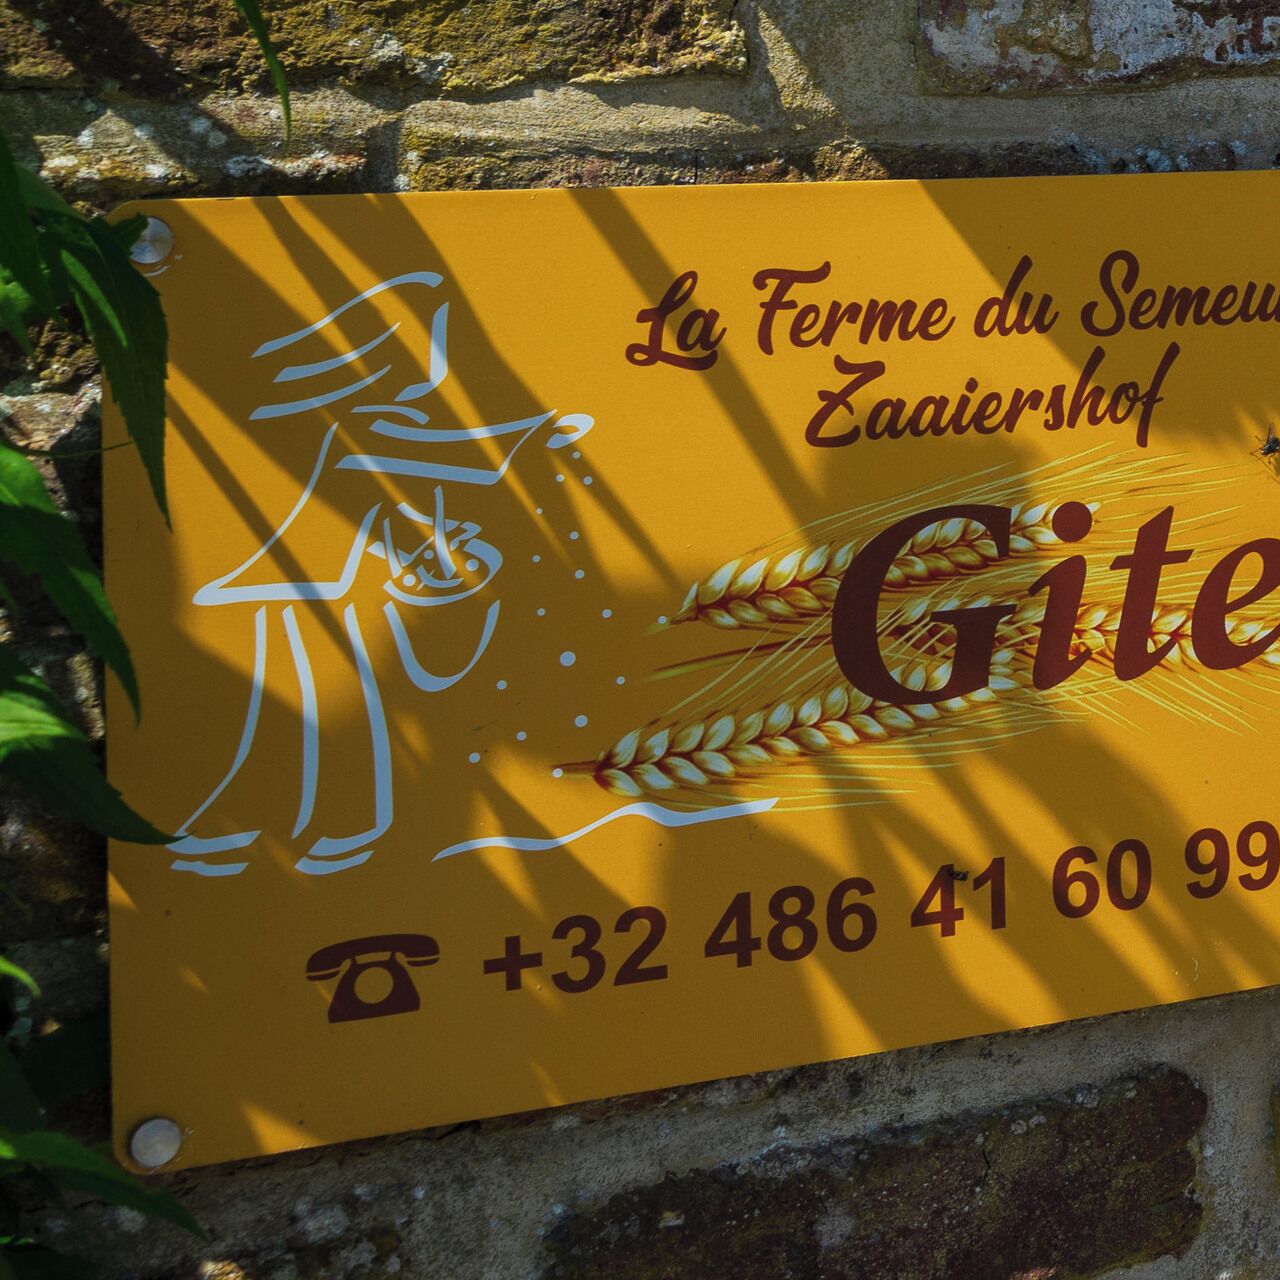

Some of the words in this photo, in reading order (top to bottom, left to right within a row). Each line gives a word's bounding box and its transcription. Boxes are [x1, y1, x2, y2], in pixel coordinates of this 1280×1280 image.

[625, 270, 727, 372] La
[752, 260, 957, 357] Ferme
[974, 254, 1059, 339] du
[804, 341, 1181, 449] Zaaiershof
[483, 905, 668, 994] +32
[704, 877, 878, 968] 486
[910, 856, 1007, 938] 41
[1052, 838, 1152, 919] 60
